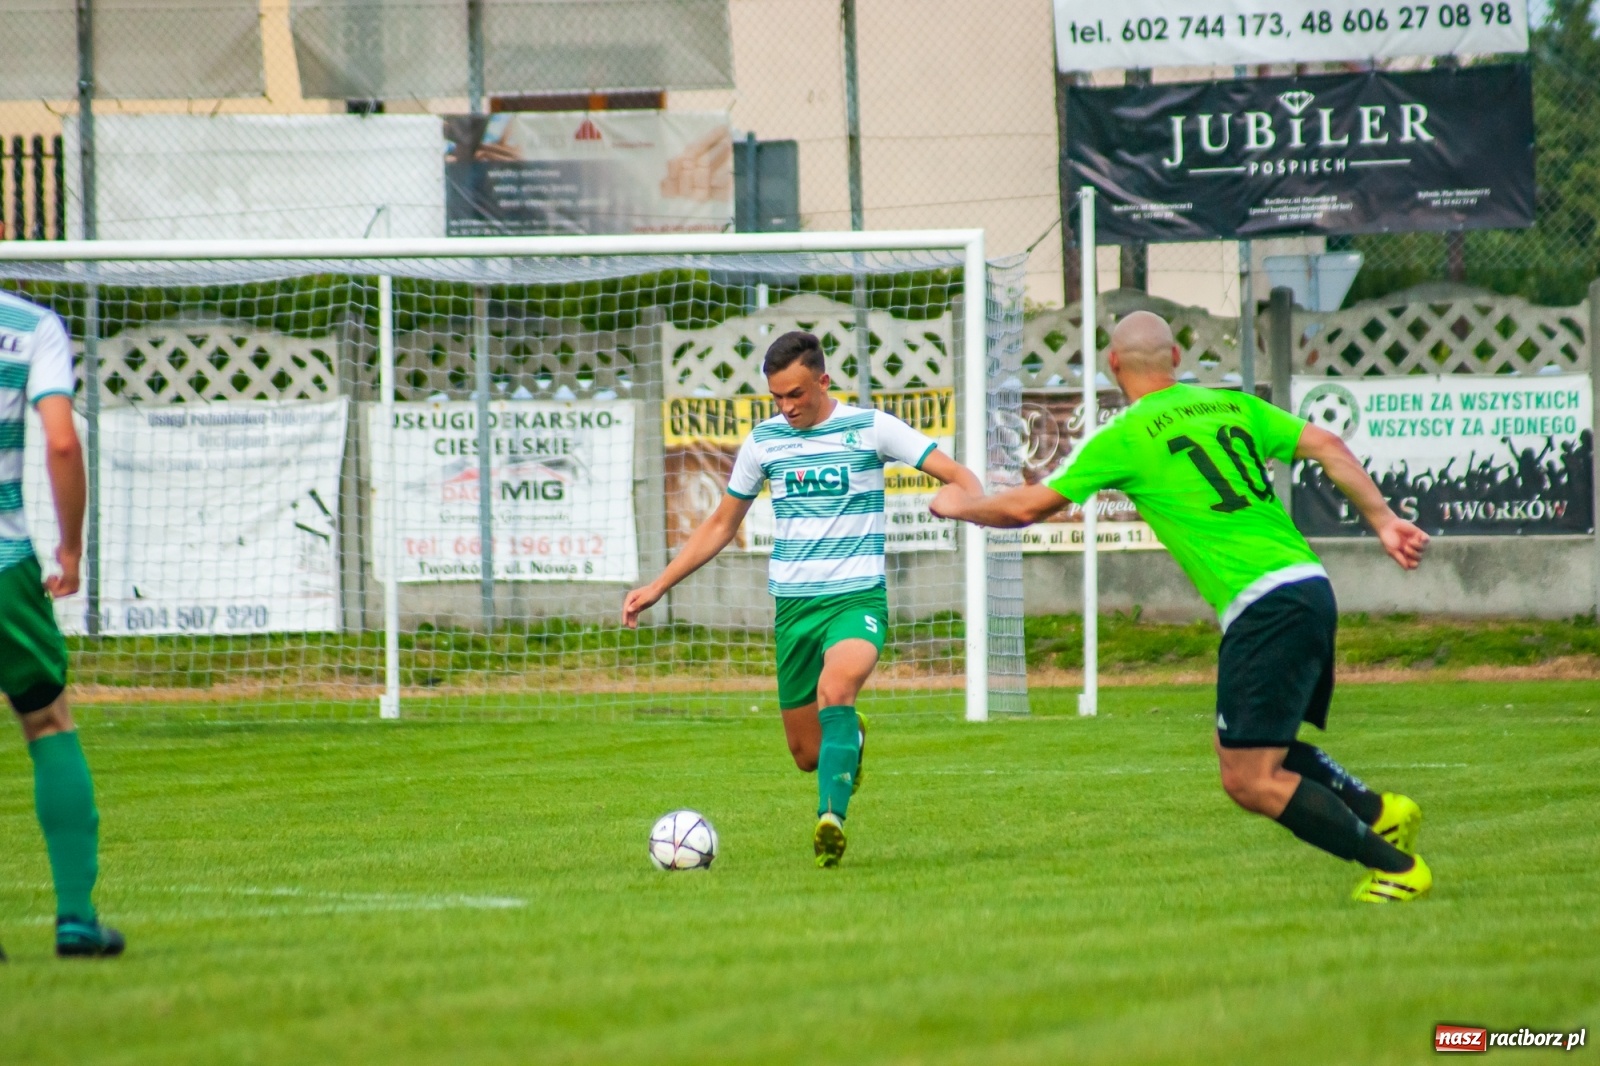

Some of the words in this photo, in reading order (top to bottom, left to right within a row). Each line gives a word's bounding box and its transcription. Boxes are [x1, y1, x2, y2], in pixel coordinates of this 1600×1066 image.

[1070, 20, 1111, 43] tel.
[1122, 17, 1169, 42] 602
[1179, 14, 1225, 39] 744
[1237, 12, 1291, 37] 173,
[1301, 10, 1332, 33] 48
[1343, 8, 1389, 33] 606
[1399, 6, 1429, 29] 27
[1439, 4, 1471, 27] 08
[1480, 2, 1512, 25] 98
[1249, 158, 1347, 176] POŚPIECH
[1365, 393, 1424, 412] JEDEN
[1431, 393, 1453, 411] ZA
[1460, 390, 1579, 411] WSZYSTKICH
[1146, 412, 1174, 439] LKS
[1368, 417, 1455, 437] WSZYSCY
[1461, 417, 1485, 435] ZA
[1491, 415, 1577, 435] JEDNEGO
[434, 437, 573, 455] CIESELSKIE
[1166, 425, 1276, 513] 10
[1340, 497, 1420, 525] LS
[1439, 494, 1569, 520] TWORKÓW
[1128, 530, 1142, 542] 11
[531, 562, 577, 574] Nowa
[584, 562, 594, 574] 8
